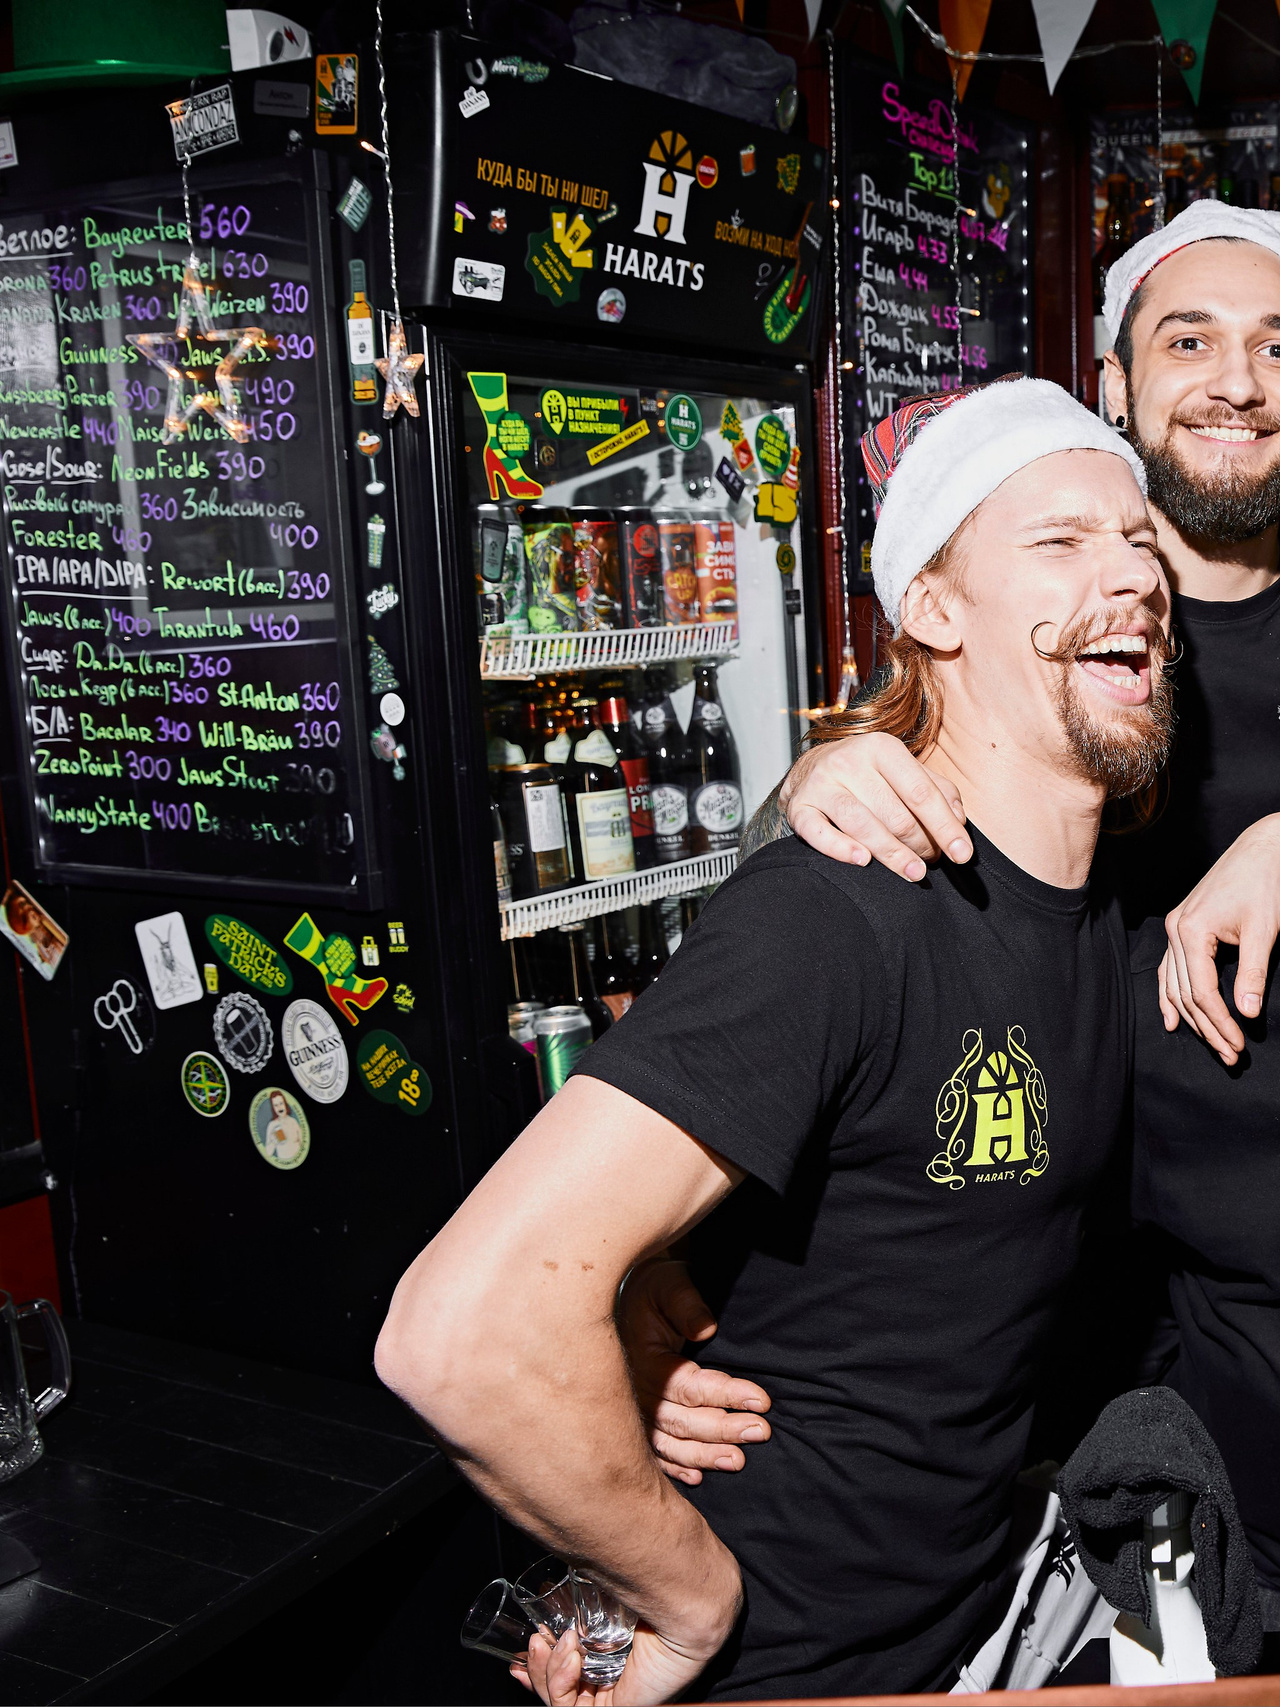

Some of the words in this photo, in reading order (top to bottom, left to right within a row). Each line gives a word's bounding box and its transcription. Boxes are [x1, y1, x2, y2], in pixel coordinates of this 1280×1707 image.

[173, 100, 235, 140] ANCONDAZ
[1096, 133, 1153, 147] QUEEN
[477, 157, 513, 188] КУДА
[516, 167, 537, 193] БЫ
[540, 173, 560, 199] ТЫ
[561, 179, 579, 203] НИ
[581, 185, 609, 211] ШЕЛ
[861, 173, 904, 217] Витя
[83, 206, 188, 258] Bayreuter
[200, 203, 250, 239] 560
[603, 242, 705, 291] HARAT'S
[917, 234, 948, 264] 4.33
[49, 266, 87, 291] 360
[90, 258, 154, 290] Petrus
[156, 247, 216, 283] triel
[223, 250, 269, 279] 630
[862, 246, 896, 285] Еша
[899, 262, 929, 293] 4.44
[55, 293, 122, 324] Kraken
[124, 295, 161, 321] 360
[270, 282, 309, 314] 390
[859, 282, 929, 326] Дождик
[60, 336, 139, 366] Guinness
[181, 338, 224, 367] Jaws
[274, 333, 315, 361] 390
[863, 316, 900, 353] Рома
[65, 374, 118, 407] Porter
[118, 379, 160, 411] 390
[245, 376, 295, 406] 490
[0, 413, 82, 441] Newcastle
[83, 416, 118, 446] 440
[243, 409, 296, 441] 450
[112, 454, 156, 482] Neon
[157, 448, 210, 479] Fields
[216, 450, 265, 481] 390
[140, 492, 178, 521] 360
[181, 487, 305, 520] Зависимость
[12, 519, 103, 551] Forester
[112, 525, 152, 553] 460
[270, 522, 319, 549] 400
[287, 570, 330, 600] 390
[21, 601, 64, 629] Jaws
[112, 607, 151, 637] 400
[153, 606, 243, 638] Tarantula
[250, 612, 300, 641] 460
[188, 653, 231, 678] 360
[169, 681, 209, 704] 360
[300, 681, 340, 711] 360
[80, 712, 154, 743] Bacalar
[155, 715, 192, 742] 340
[294, 720, 341, 749] 390
[125, 751, 171, 781] 300
[177, 757, 225, 787] Jaws
[628, 784, 651, 795] LON
[152, 799, 191, 831] 400
[228, 921, 277, 962] SAINT
[228, 952, 262, 983] DAY
[289, 1033, 342, 1067] GUINNESS
[975, 1170, 1016, 1183] HARAT'S
